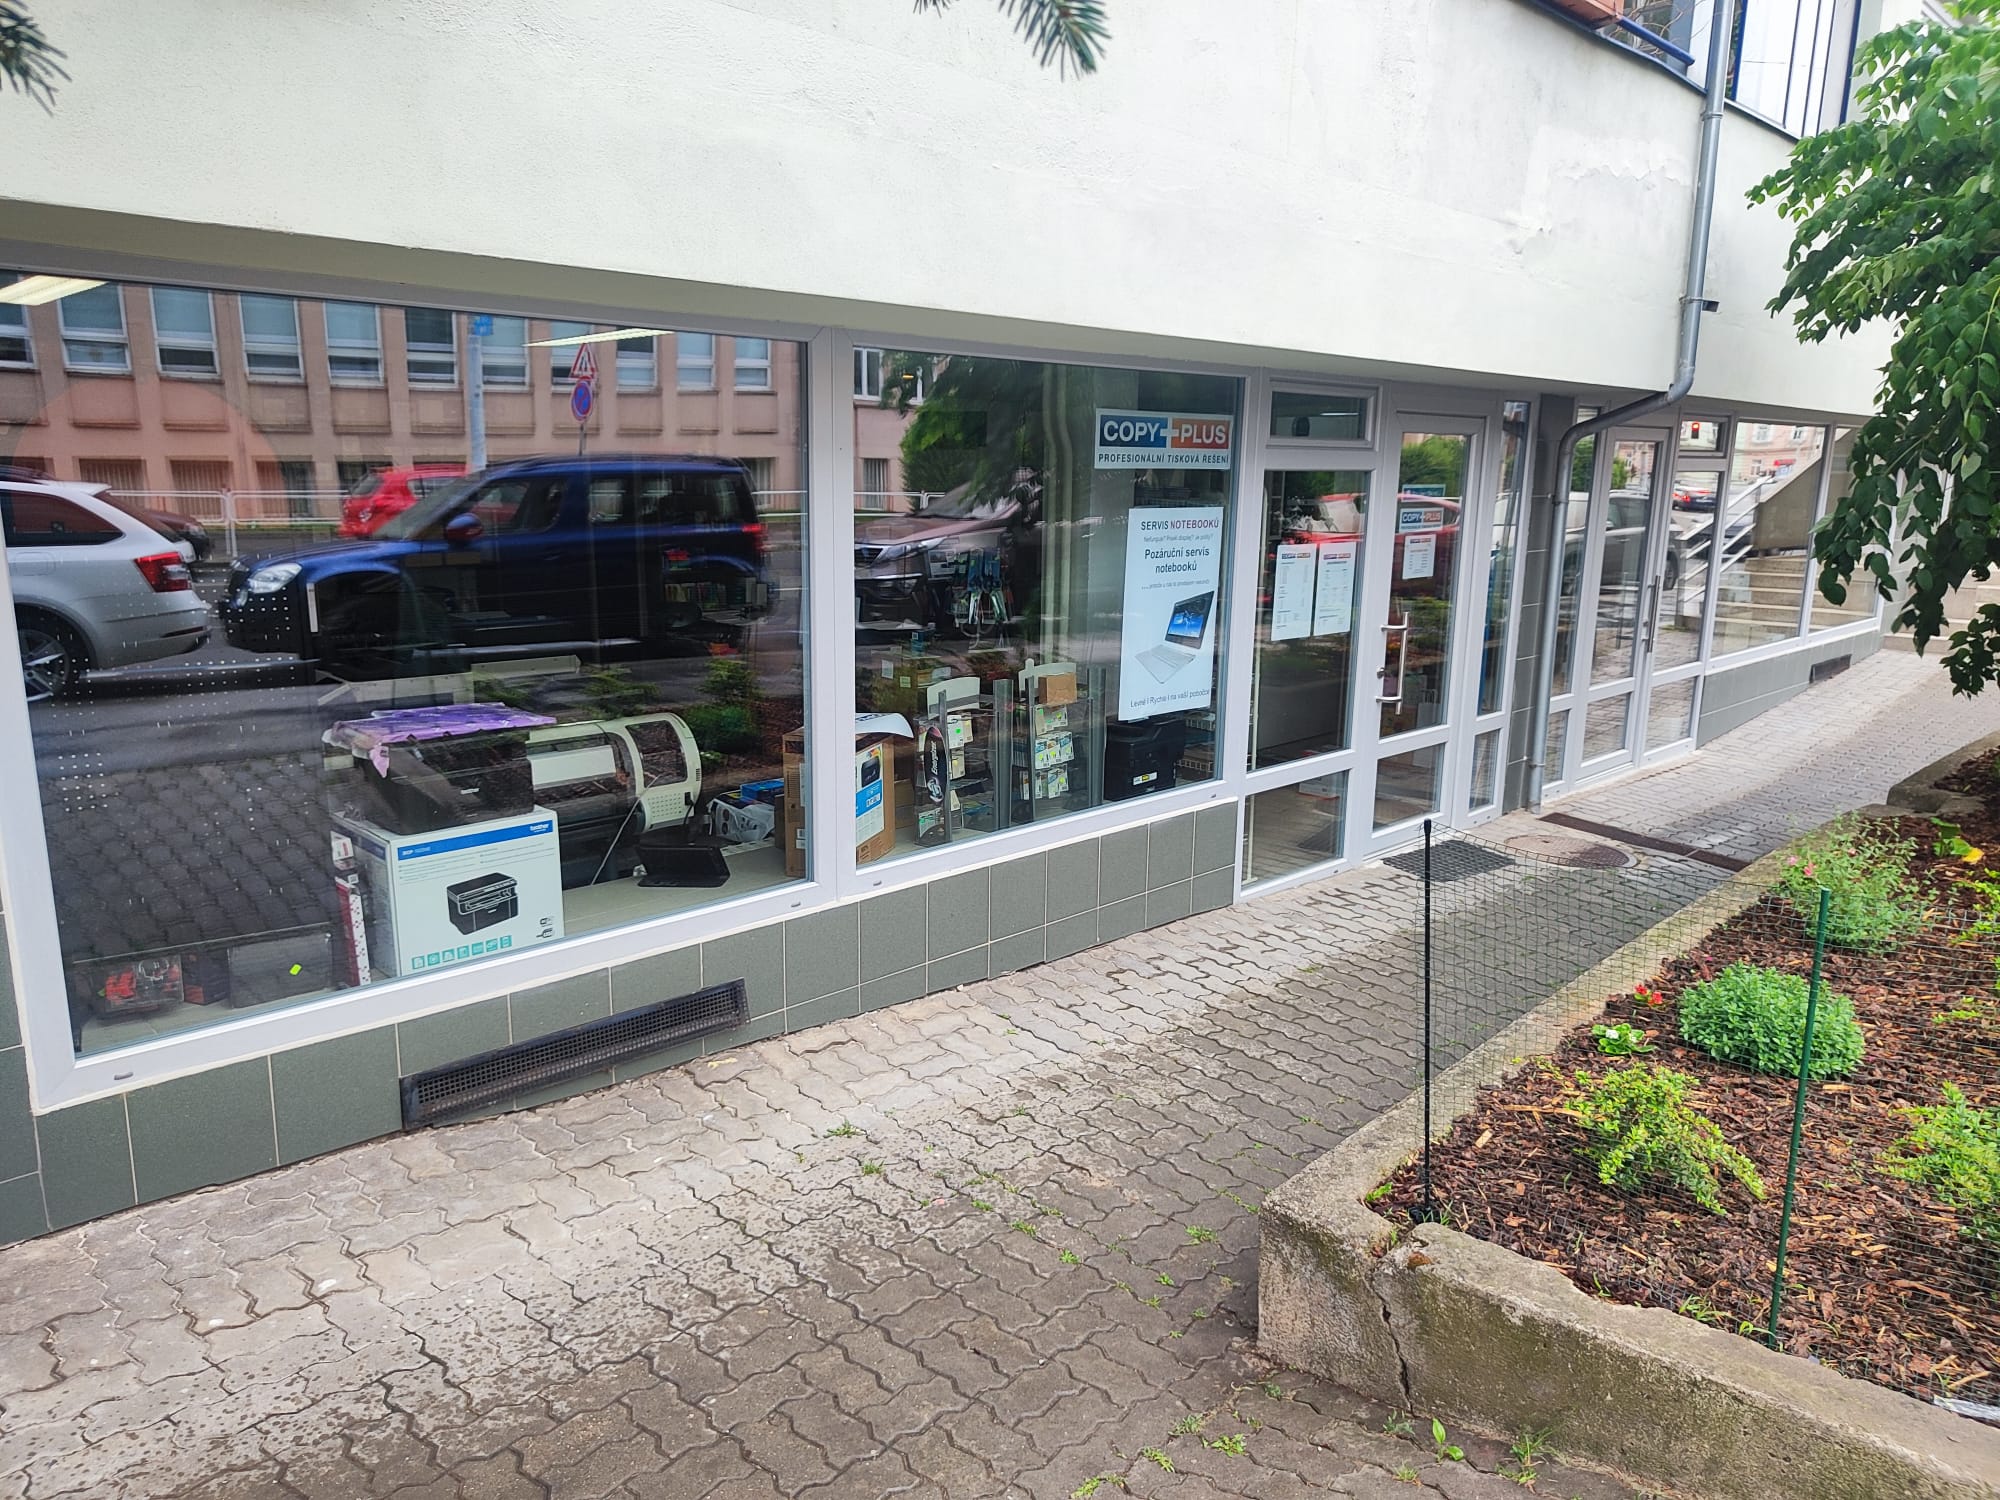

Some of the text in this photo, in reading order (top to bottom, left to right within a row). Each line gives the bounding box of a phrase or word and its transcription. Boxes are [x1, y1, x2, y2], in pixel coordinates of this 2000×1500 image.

[1103, 420, 1226, 444] COPY PLUS
[1098, 451, 1229, 464] PROFESIONÁLNÍ TISKOVÁ ŘEŠENÍ
[1140, 517, 1219, 531] SERVIS NOTEBOOKŮ
[1144, 547, 1210, 559] Pozáruční servis
[1155, 560, 1197, 574] notebooků
